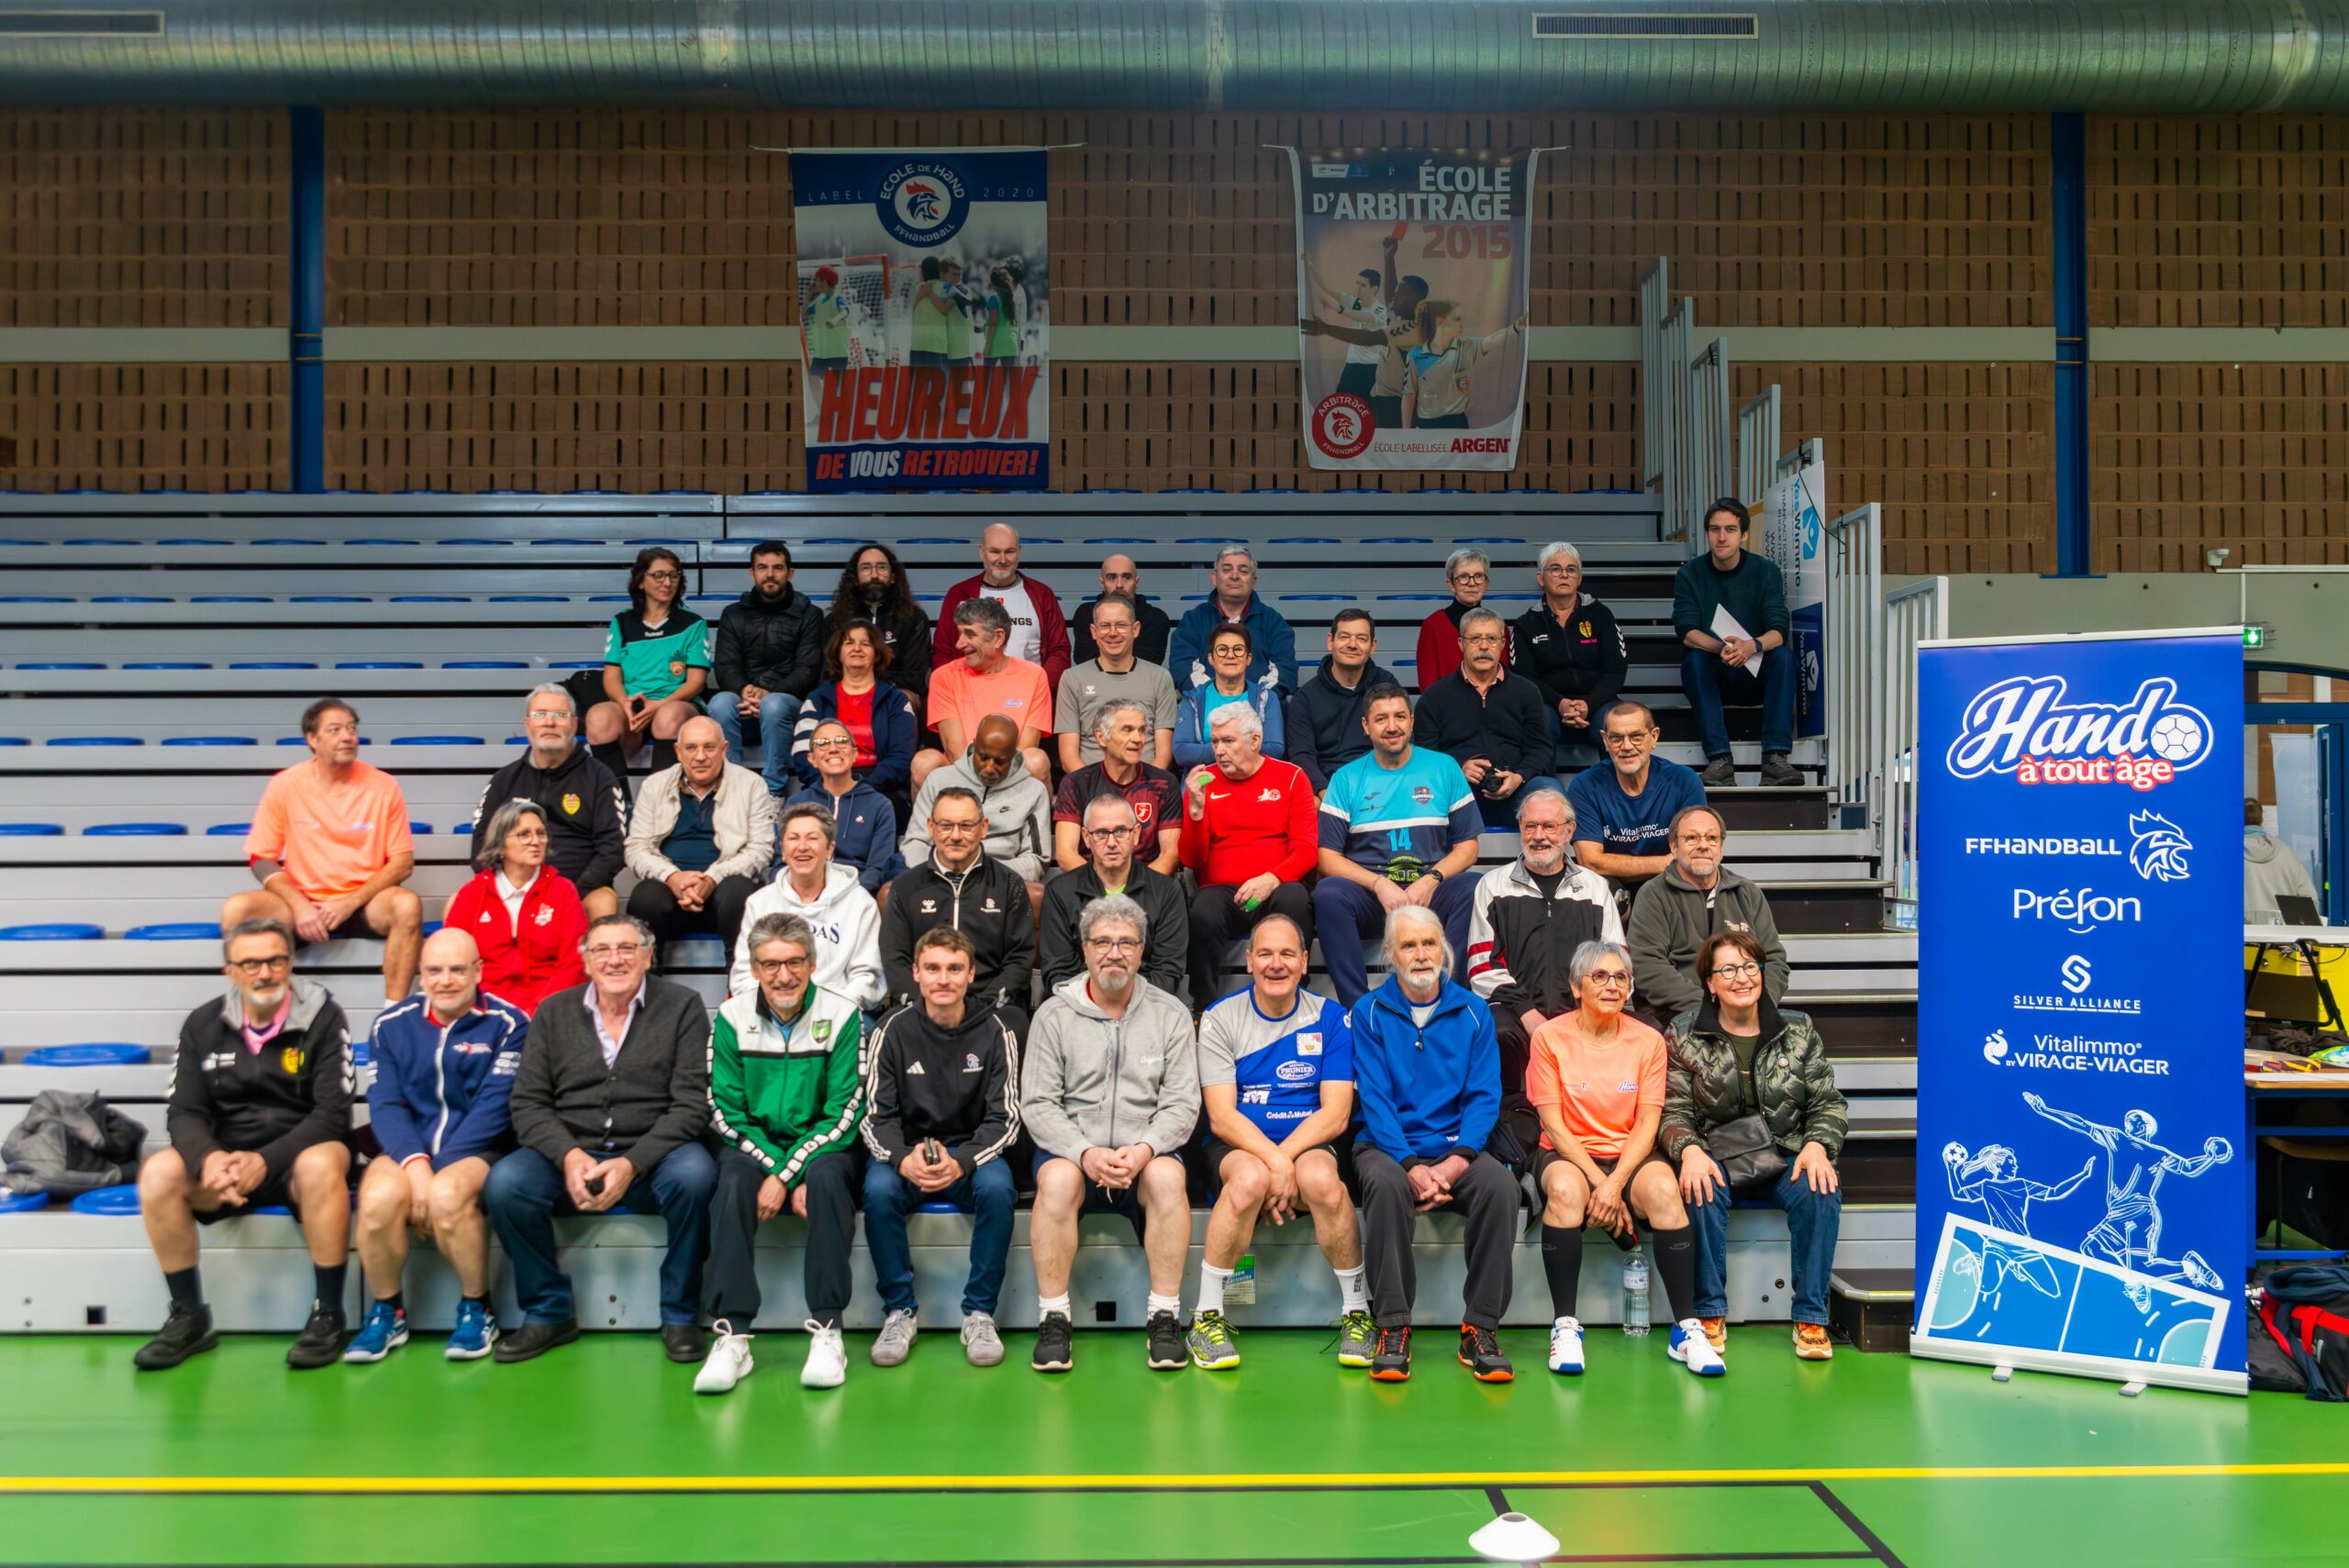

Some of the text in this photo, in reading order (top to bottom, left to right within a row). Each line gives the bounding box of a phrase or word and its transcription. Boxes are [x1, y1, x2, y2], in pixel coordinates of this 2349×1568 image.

[918, 164, 930, 173] DE
[1419, 159, 1511, 192] ÉCOLE
[807, 190, 864, 202] LABEL
[983, 186, 1035, 198] 2020
[1422, 224, 1512, 260] 2015
[817, 365, 1041, 442] HEUREUX
[1375, 438, 1511, 453] ÉCOLE LABELLISÉE ARGEN
[816, 453, 846, 480] DE
[850, 450, 901, 477] VOUS
[1011, 617, 1032, 627] NGS
[1957, 686, 2167, 769] Hand
[2020, 754, 2173, 789] à tout âge
[1386, 827, 1413, 851] 14
[2014, 887, 2142, 923] Préfon
[2014, 995, 2142, 1010] SILVER ALLIANCE
[1280, 1066, 1314, 1074] PRUNIER
[2014, 1051, 2169, 1075] VIRAGE-VIAGER
[1266, 1111, 1287, 1119] Crédit
